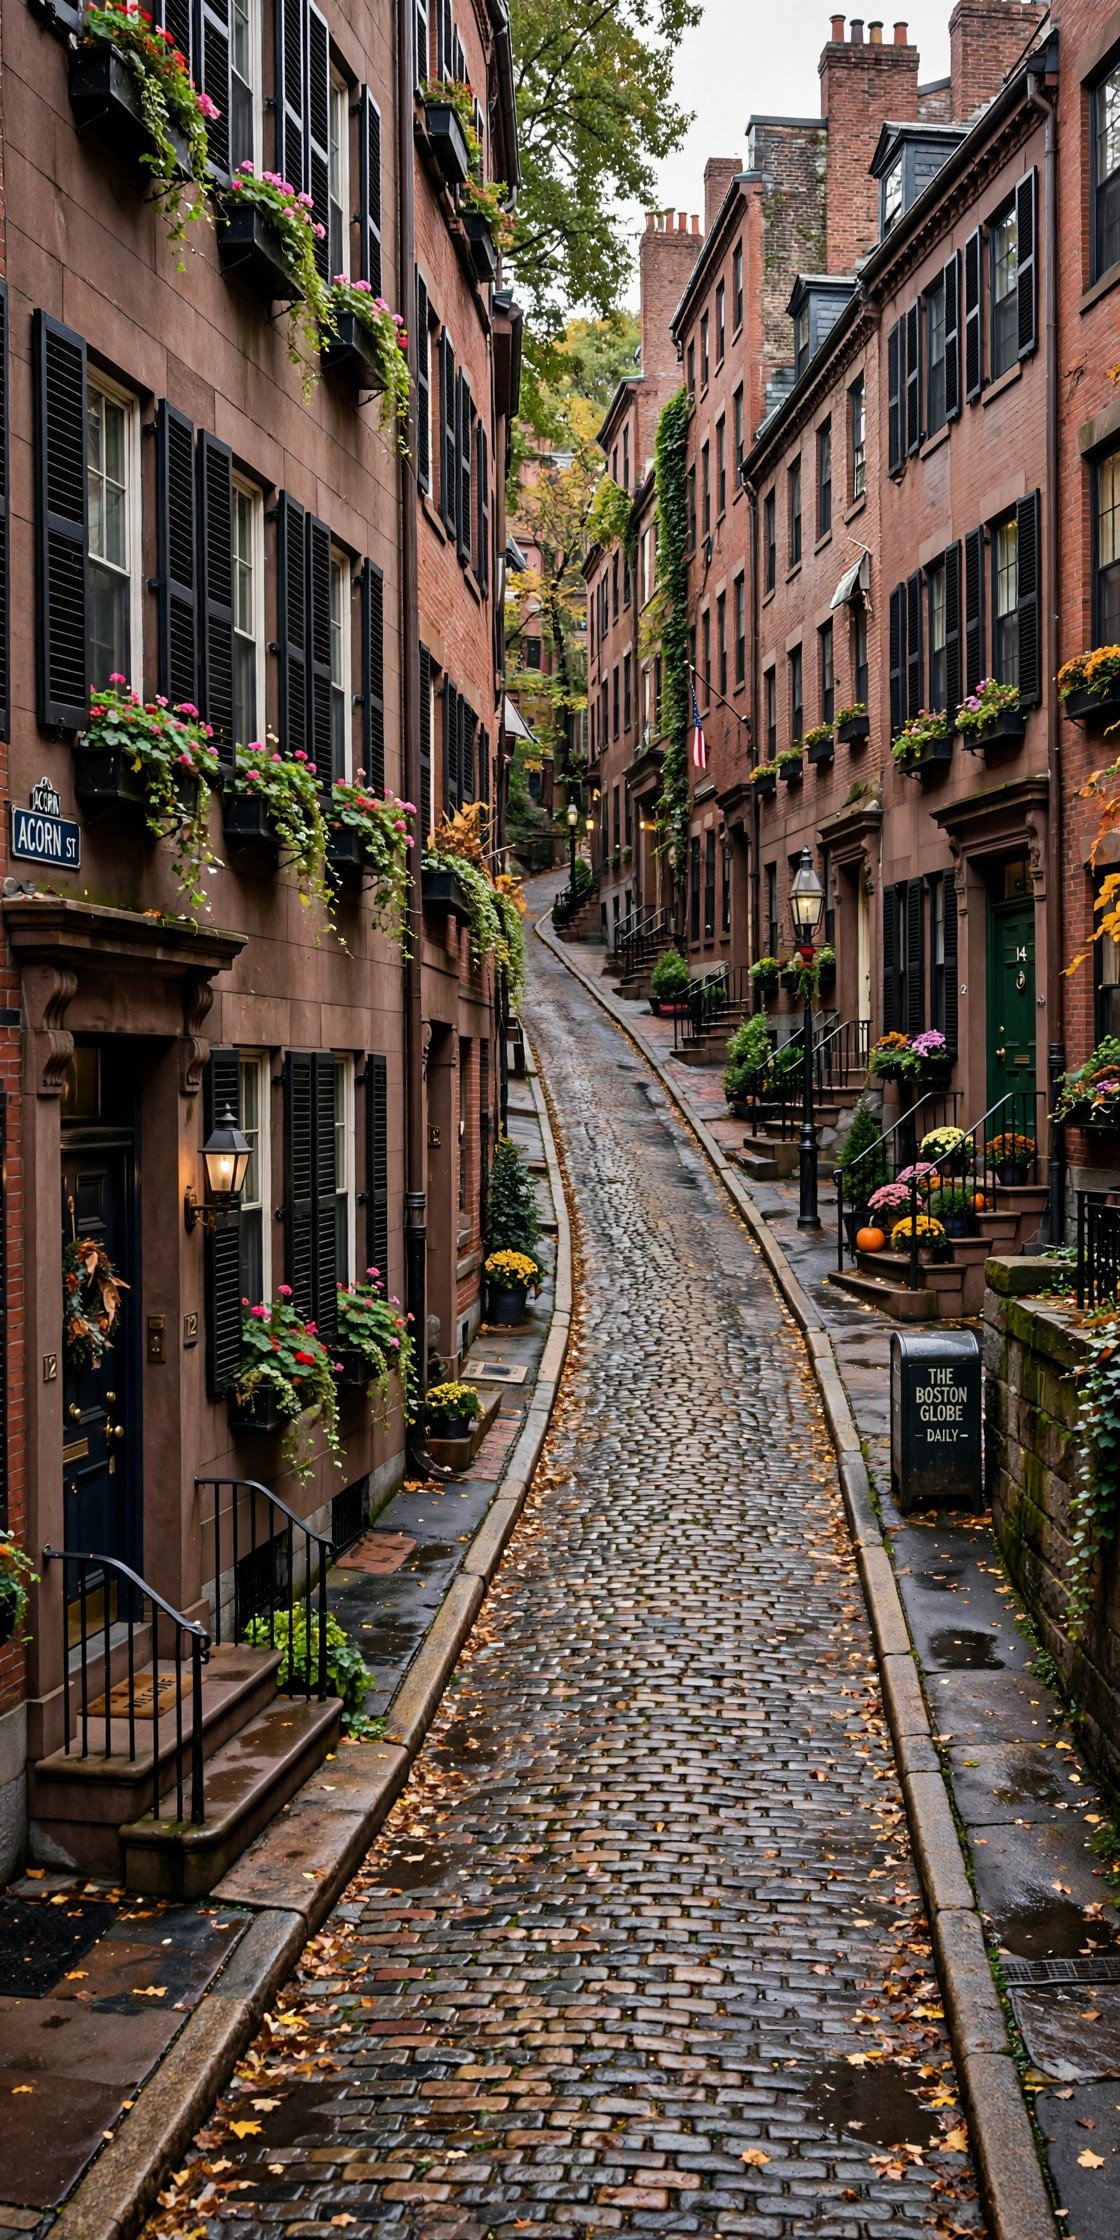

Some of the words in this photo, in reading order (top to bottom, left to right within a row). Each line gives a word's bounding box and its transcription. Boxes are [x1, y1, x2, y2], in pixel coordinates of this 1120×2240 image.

[18, 816, 62, 857] ACORN
[66, 837, 76, 858] ST
[1016, 946, 1027, 962] 14
[184, 1314, 197, 1337] 12
[44, 1355, 57, 1380] 12
[928, 1368, 954, 1385] THE
[915, 1386, 967, 1403] BOSTON
[920, 1405, 964, 1422] GLOBE
[926, 1428, 959, 1442] DAILY
